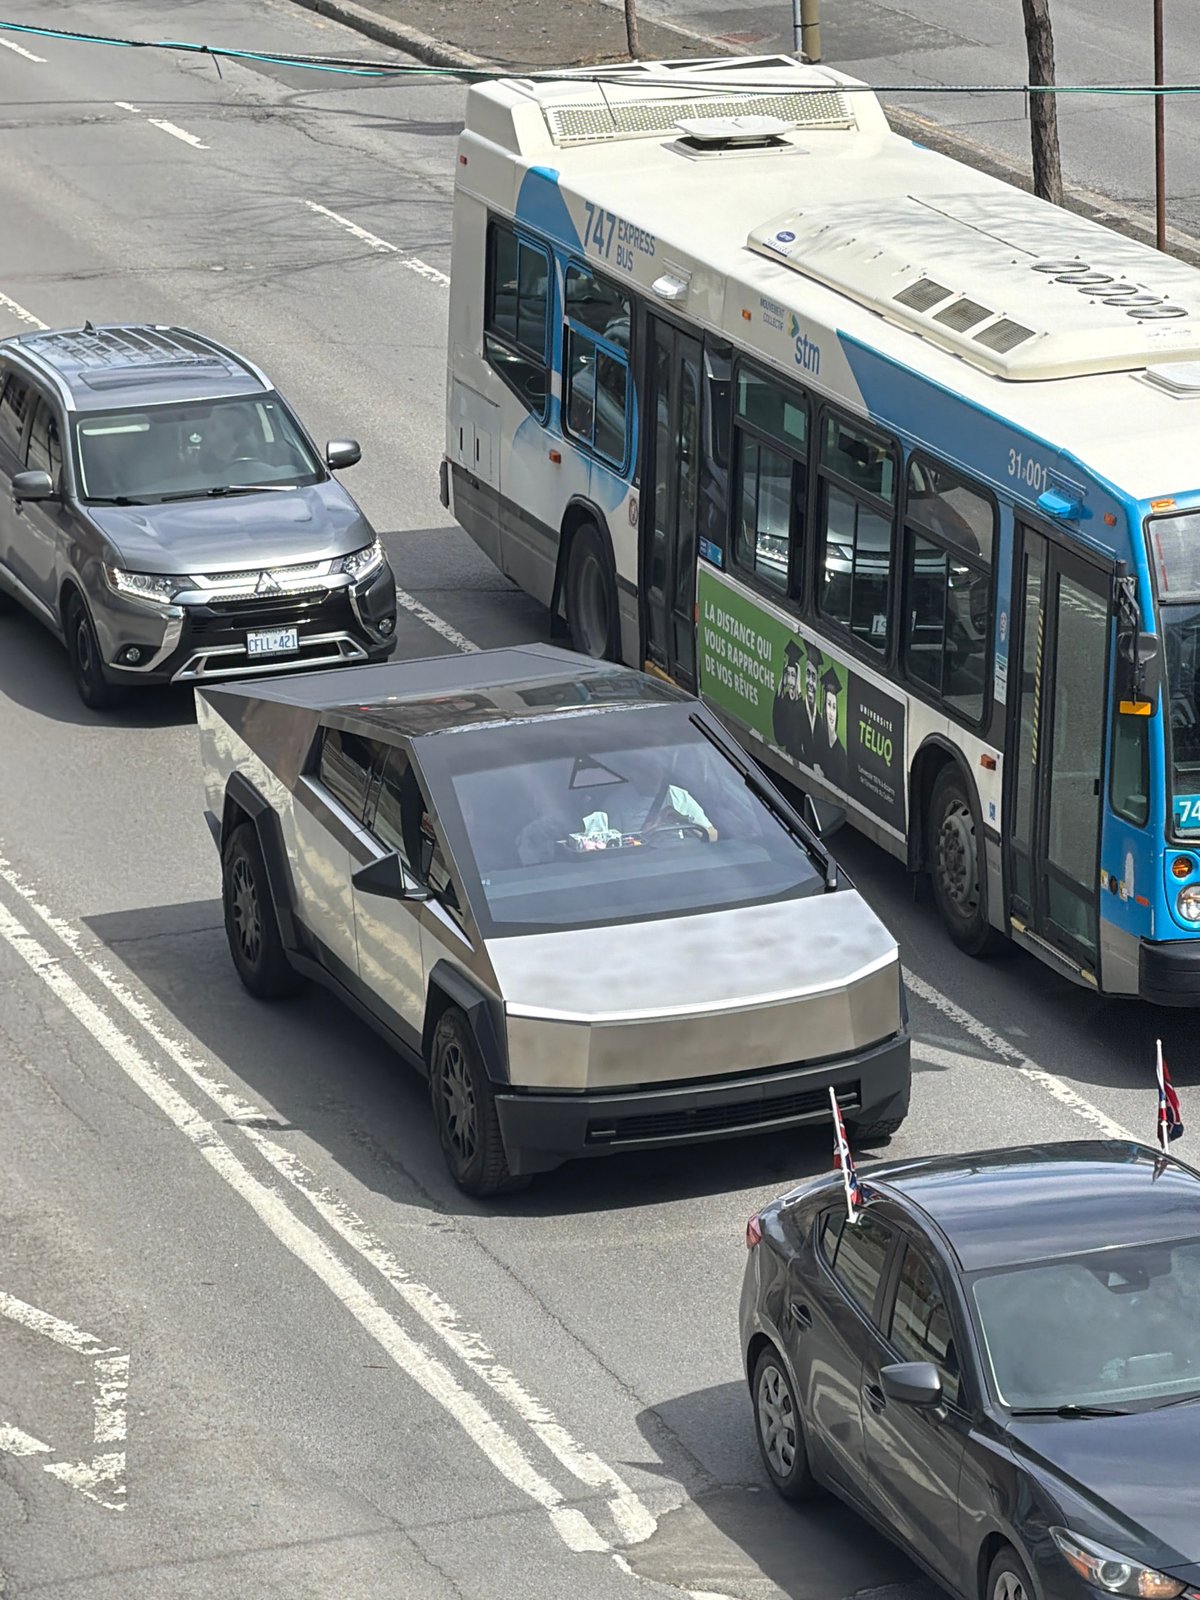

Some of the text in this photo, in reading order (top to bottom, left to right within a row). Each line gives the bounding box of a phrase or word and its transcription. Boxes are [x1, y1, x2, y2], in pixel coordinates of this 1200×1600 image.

[584, 201, 616, 258] 747
[618, 218, 656, 256] EXPRESS
[616, 244, 634, 272] BUS
[760, 298, 784, 318] MOUVEMENT
[763, 312, 784, 331] COLLECTIF
[794, 334, 820, 375] stm
[248, 634, 296, 652] CFLL 421
[704, 600, 772, 662] LA DISTANCE QUI
[704, 626, 775, 691] VOUS RAPPROCHE
[705, 654, 716, 677] DE
[716, 661, 733, 688] VOS
[860, 704, 893, 732] UNIVERSITÉ
[859, 719, 893, 767] TÉLUQ
